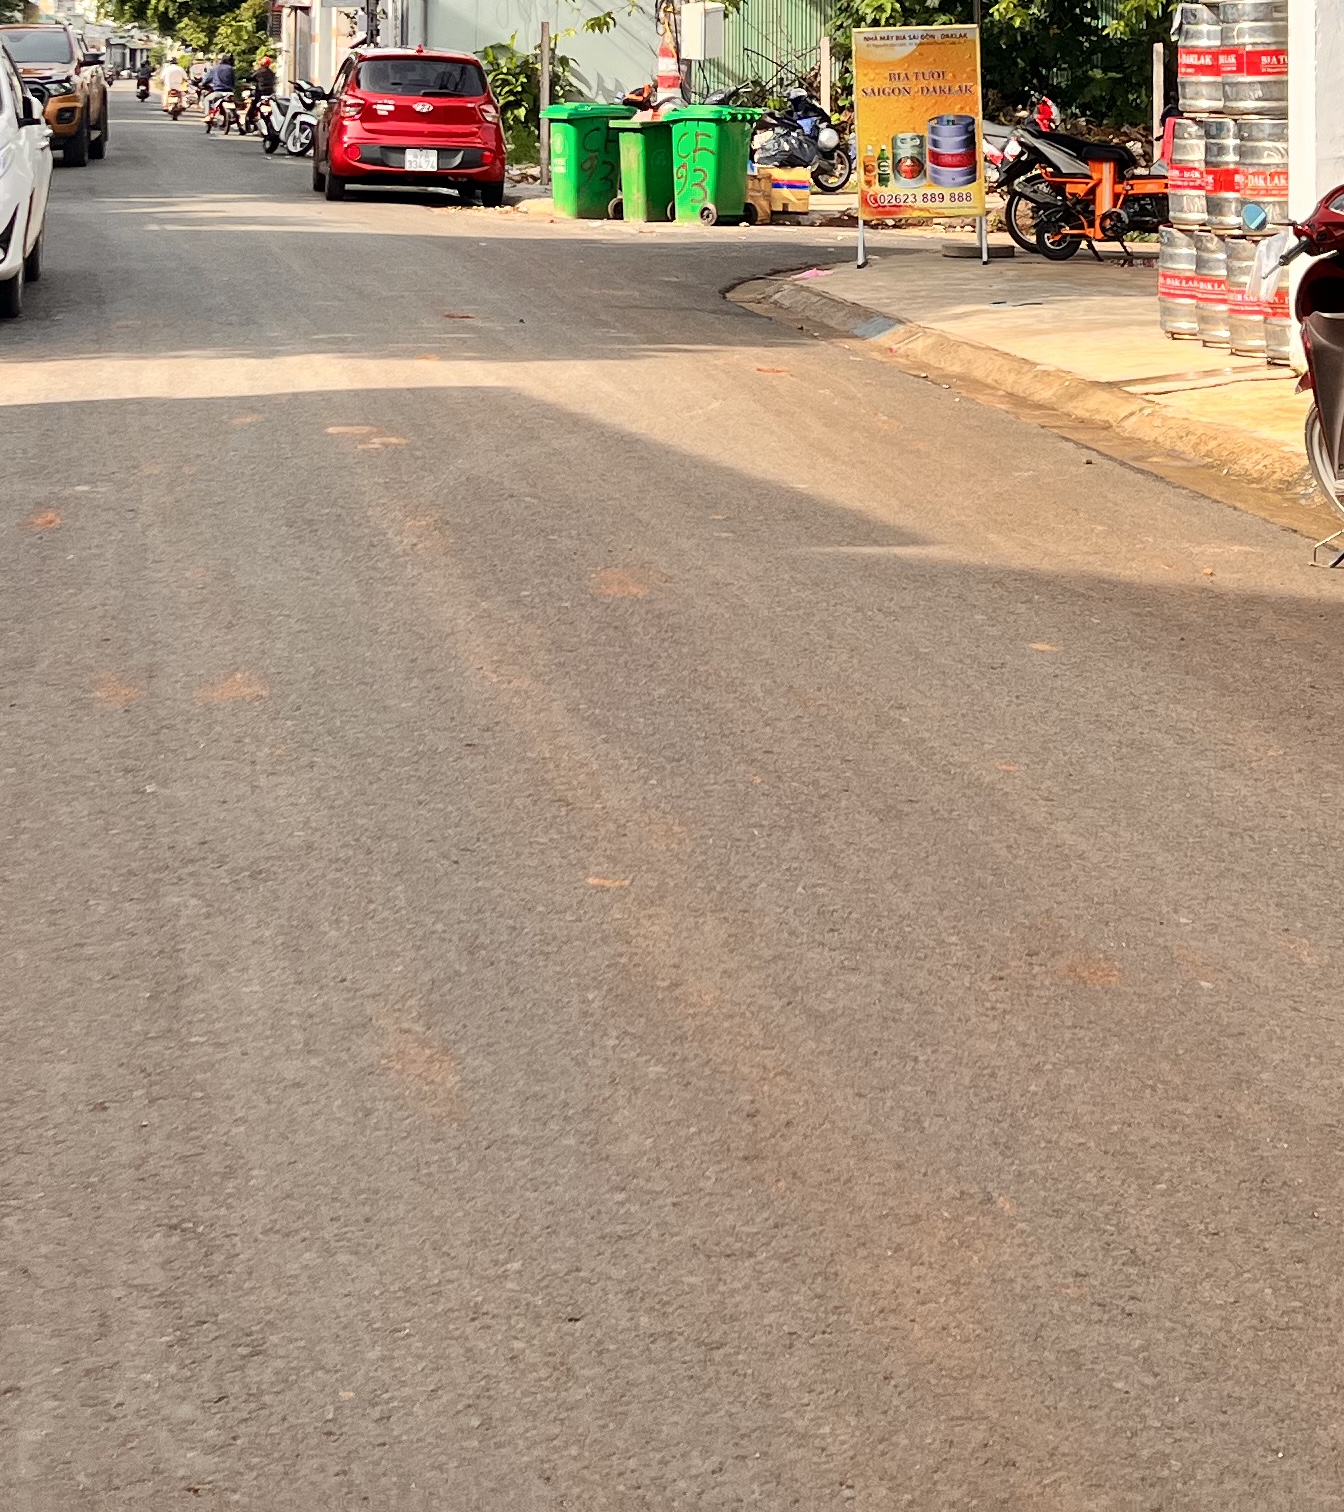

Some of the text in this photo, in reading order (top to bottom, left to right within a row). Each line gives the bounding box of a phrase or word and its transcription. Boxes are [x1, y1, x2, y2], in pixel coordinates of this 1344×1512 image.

[889, 71, 910, 82] BIA
[675, 162, 709, 204] 93
[949, 191, 972, 202] 888
